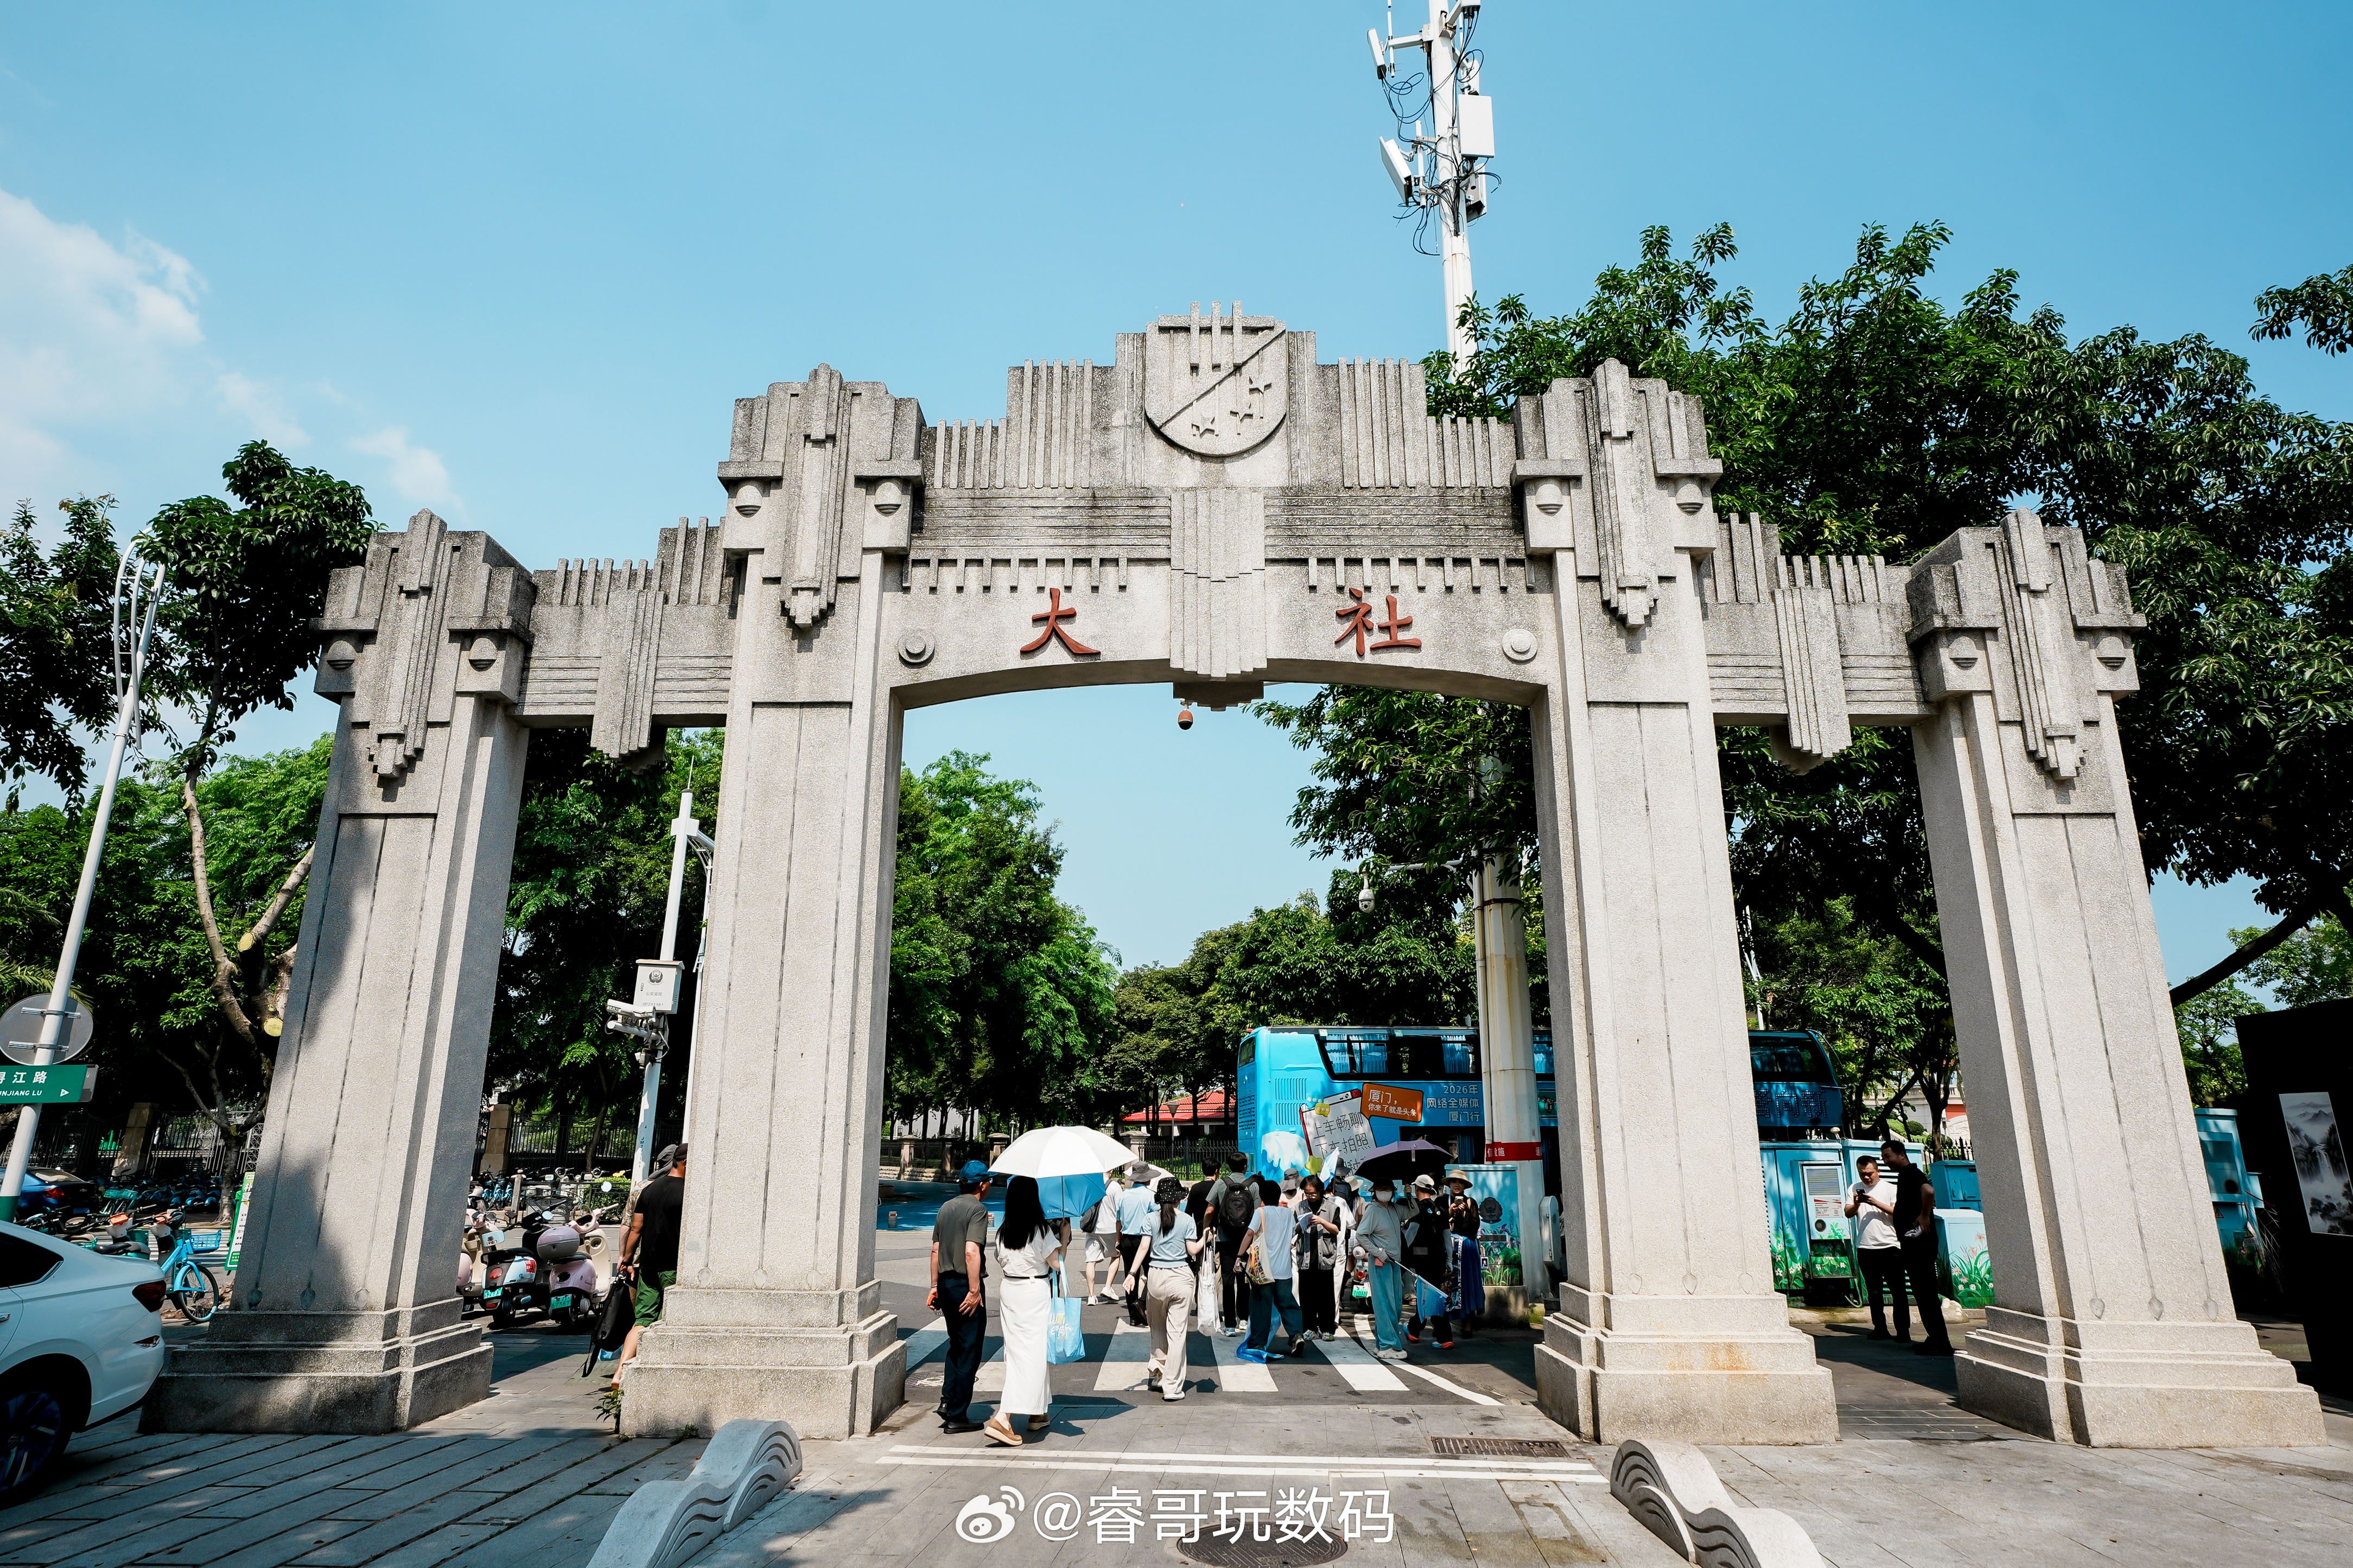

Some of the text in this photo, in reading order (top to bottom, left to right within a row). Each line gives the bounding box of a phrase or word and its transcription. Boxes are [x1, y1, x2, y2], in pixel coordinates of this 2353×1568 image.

[1020, 588, 1422, 656] 大 社
[1443, 1085, 1479, 1094] 2026年
[1427, 1098, 1479, 1108] 网络全媒体
[1368, 1104, 1417, 1117] 你来了就是头条
[1448, 1111, 1480, 1122] 厦门行
[1313, 1112, 1364, 1139] 上车畅聊
